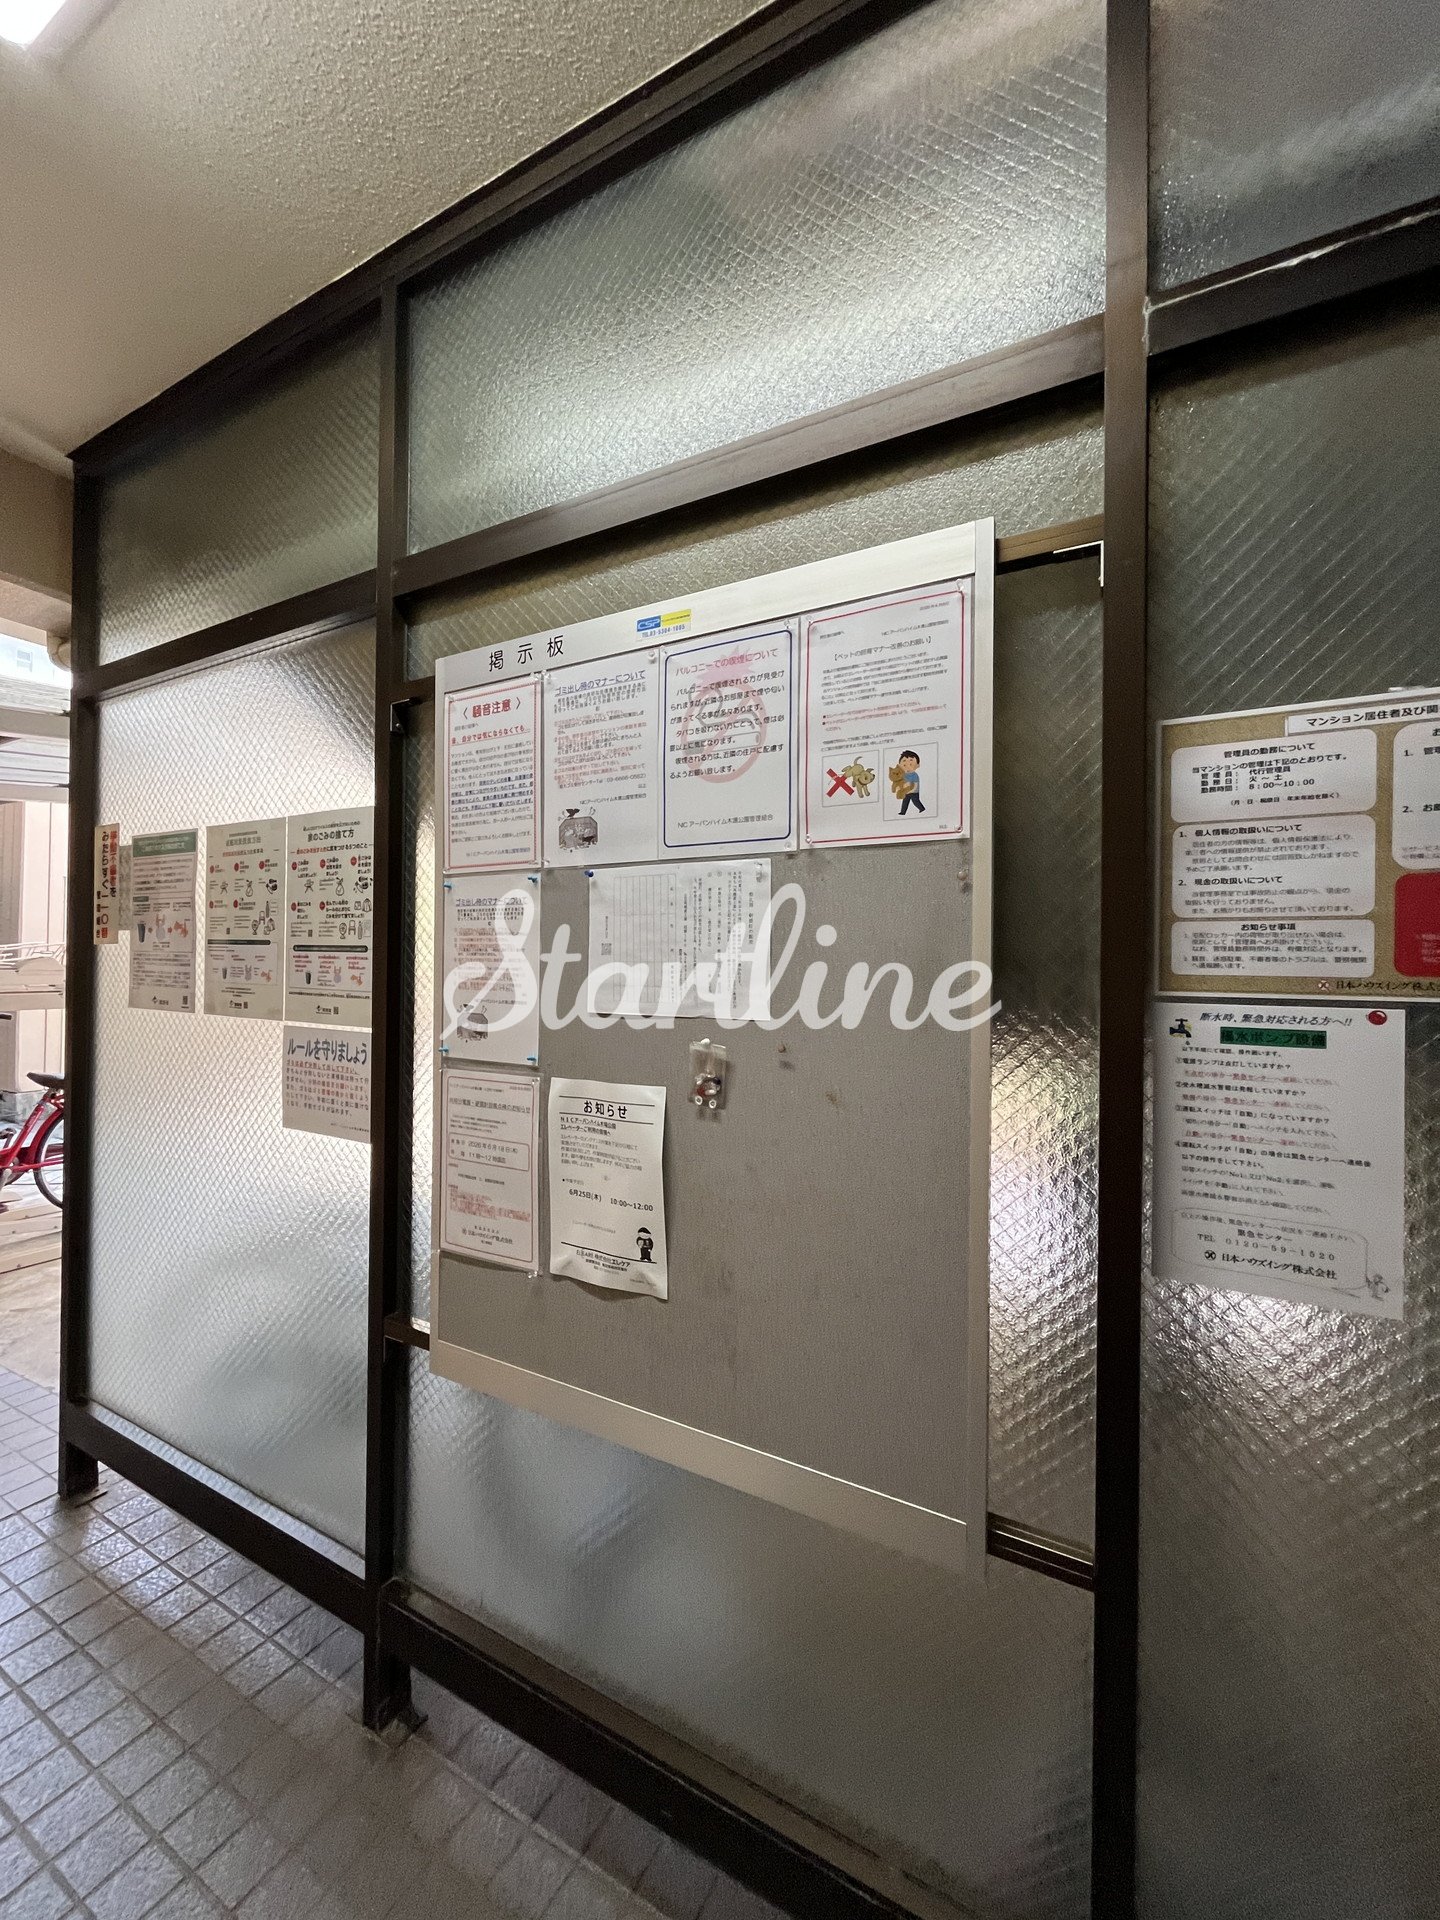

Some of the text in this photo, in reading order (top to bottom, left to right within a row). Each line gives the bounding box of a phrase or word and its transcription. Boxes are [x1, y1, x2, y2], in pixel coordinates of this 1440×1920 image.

[637, 618, 660, 630] CSP
[489, 634, 564, 672] 掲示板
[676, 648, 779, 676] バルコニーでの喫煙について
[676, 670, 785, 696] バルコニーで喫煙される方が見受け
[1223, 742, 1316, 759] 管理員の勤務について
[1192, 753, 1348, 774] 当マンションの管理は下記のとおりです。
[1249, 766, 1291, 776] 代行管理員
[1194, 823, 1302, 837] 個人情報の取扱いについて
[1194, 875, 1284, 886] 現金の取扱いについて
[1241, 922, 1296, 931] お知らせ事項
[1335, 980, 1440, 993] 日本ハウズイング株式
[1199, 1011, 1353, 1027] 断水時、緊急対応される方へ!!
[287, 1037, 368, 1066] ルールを守りましょう
[583, 1100, 628, 1120] お知らせ
[569, 1189, 602, 1203] 6月25日(木)
[1197, 1233, 1215, 1243] TEL
[1237, 1228, 1293, 1242] 緊急センター
[1221, 1252, 1338, 1280] 日本ハウズイング株式会社
